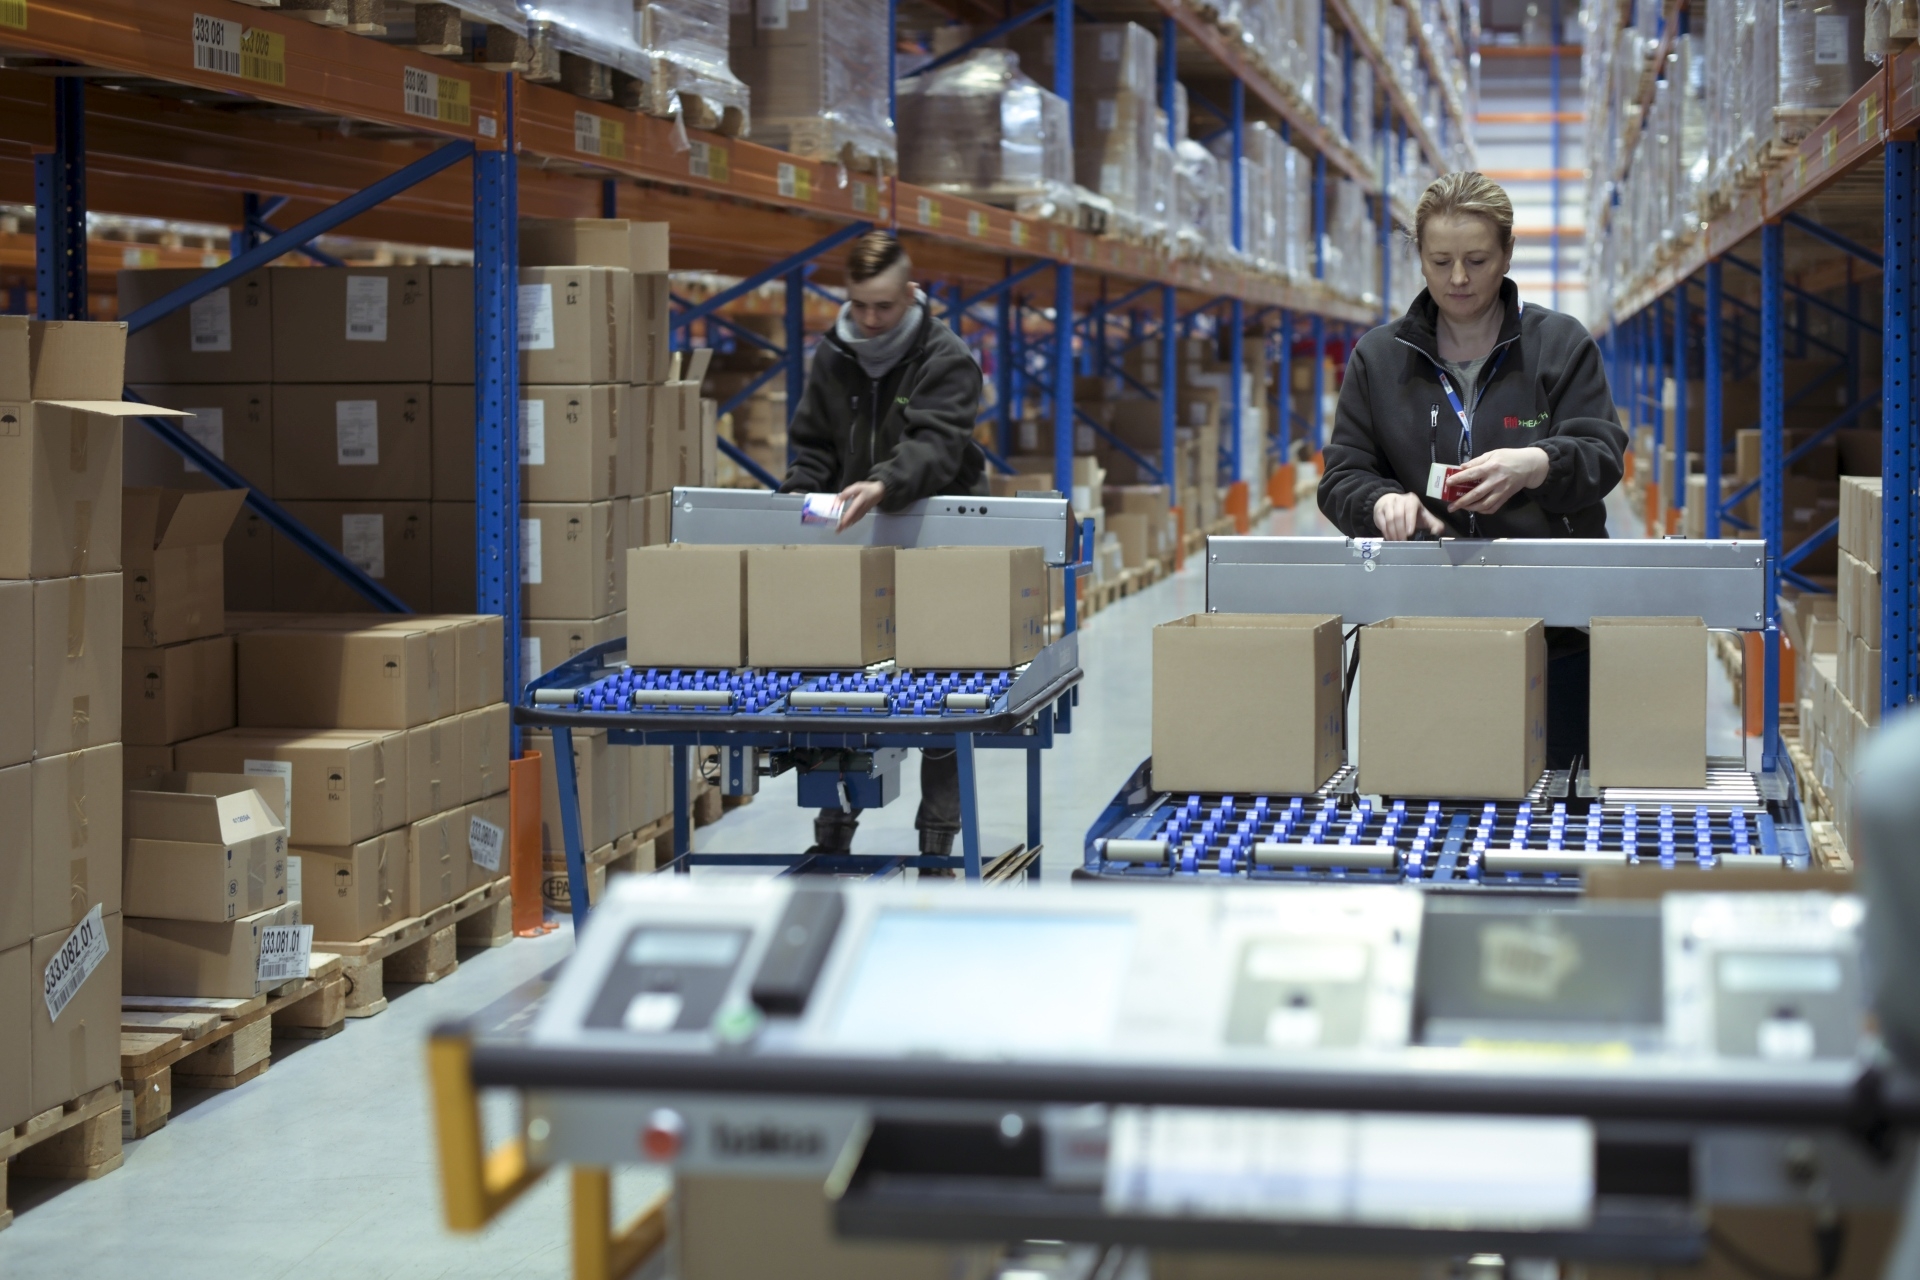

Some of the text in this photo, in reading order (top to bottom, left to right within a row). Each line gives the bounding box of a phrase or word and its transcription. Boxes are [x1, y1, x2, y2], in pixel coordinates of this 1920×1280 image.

[195, 17, 224, 46] 333 081
[548, 880, 571, 898] EPA
[45, 918, 94, 995] 333.082.01
